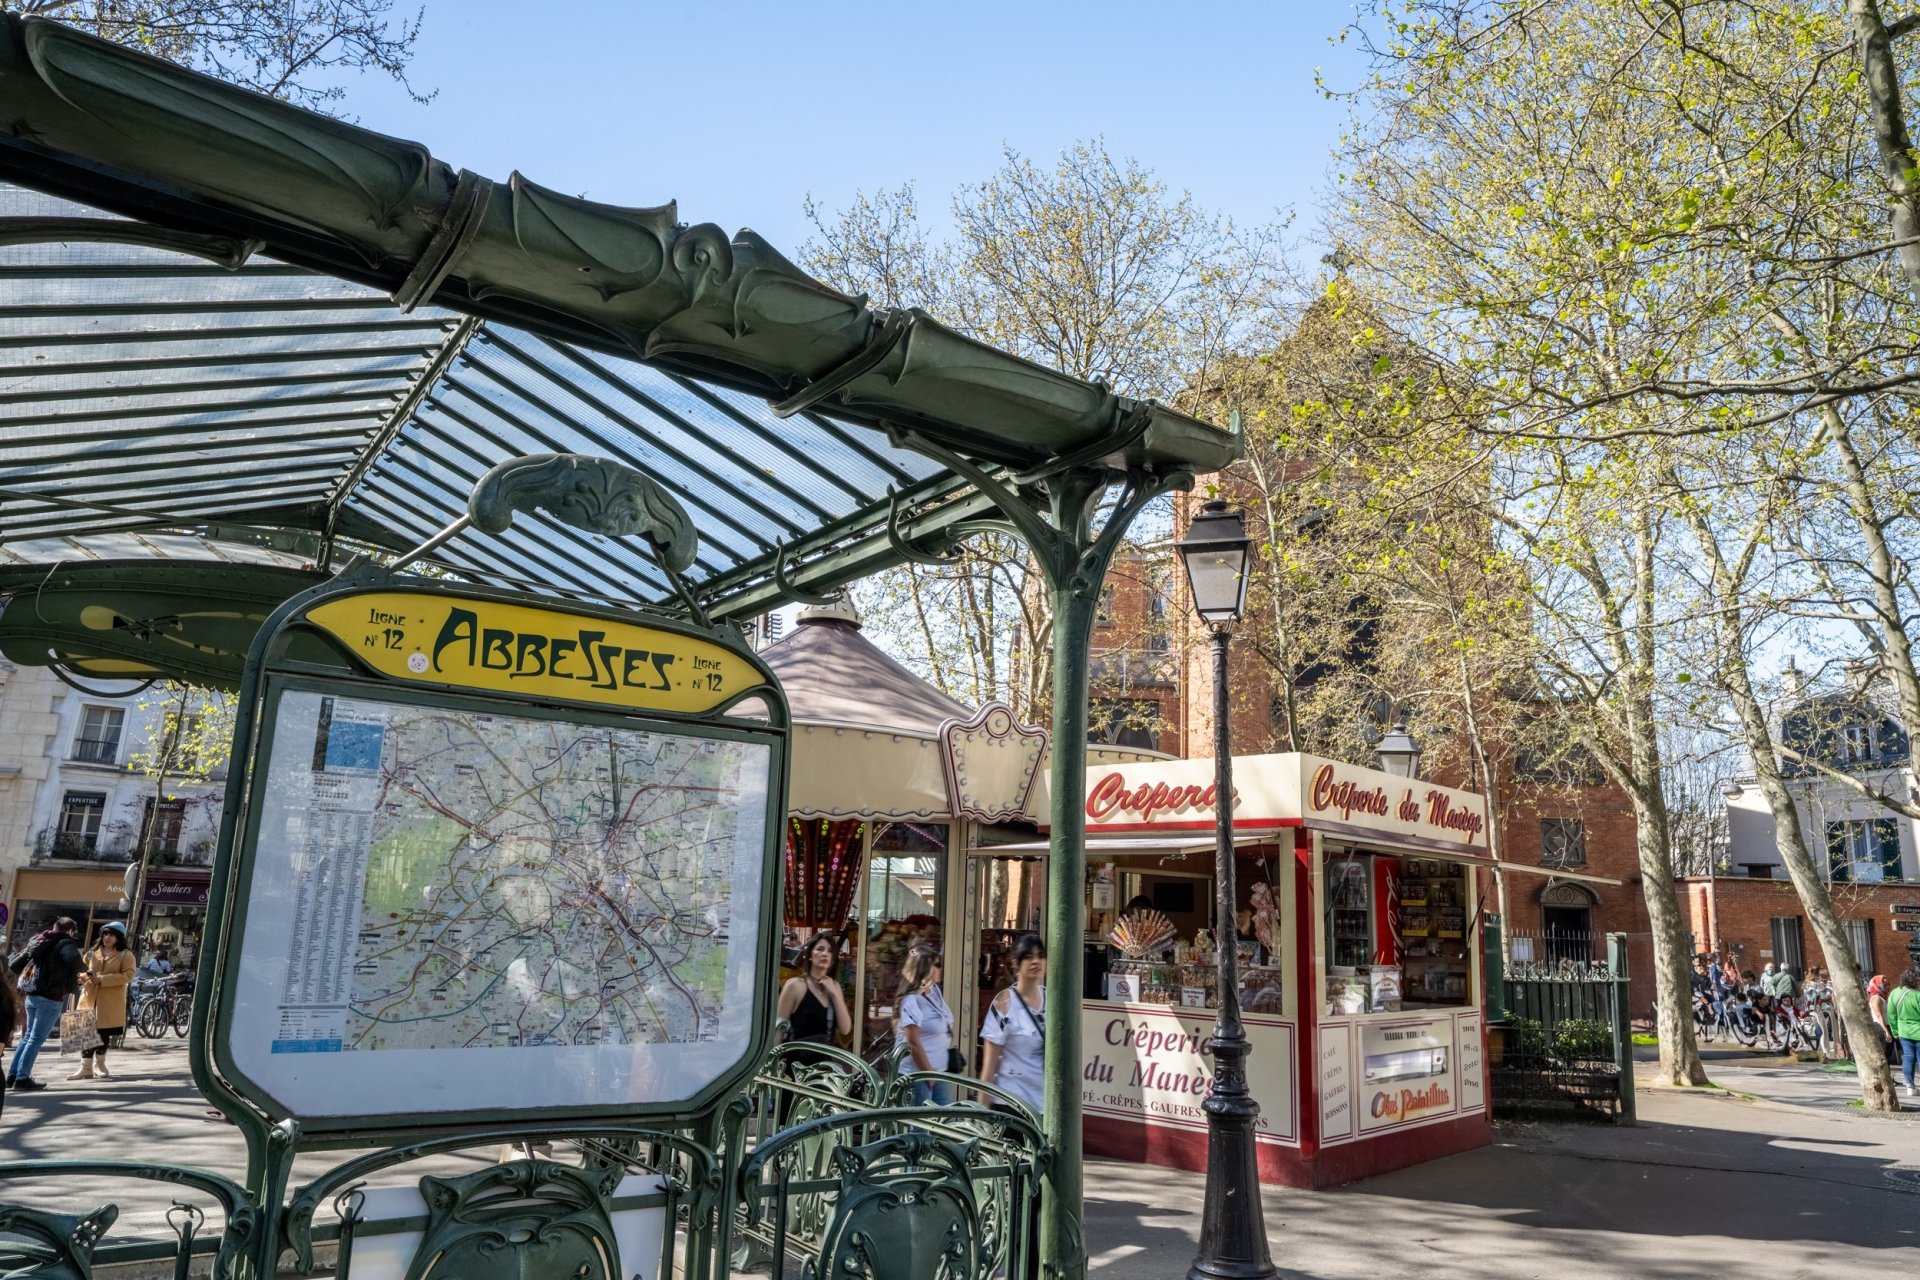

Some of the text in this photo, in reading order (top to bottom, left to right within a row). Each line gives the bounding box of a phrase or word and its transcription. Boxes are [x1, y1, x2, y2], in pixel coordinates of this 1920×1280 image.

[382, 628, 405, 650] 12
[432, 606, 675, 691] ABBESSES
[706, 672, 723, 692] 12
[1086, 772, 1238, 821] Crêperi
[1309, 764, 1483, 845] Crêperie du Manège
[151, 881, 193, 896] Souliers
[1104, 1019, 1214, 1057] Crêperie
[1084, 1054, 1114, 1084] du
[1102, 1093, 1143, 1109] CRÊPES
[1150, 1101, 1202, 1118] GAUFRES
